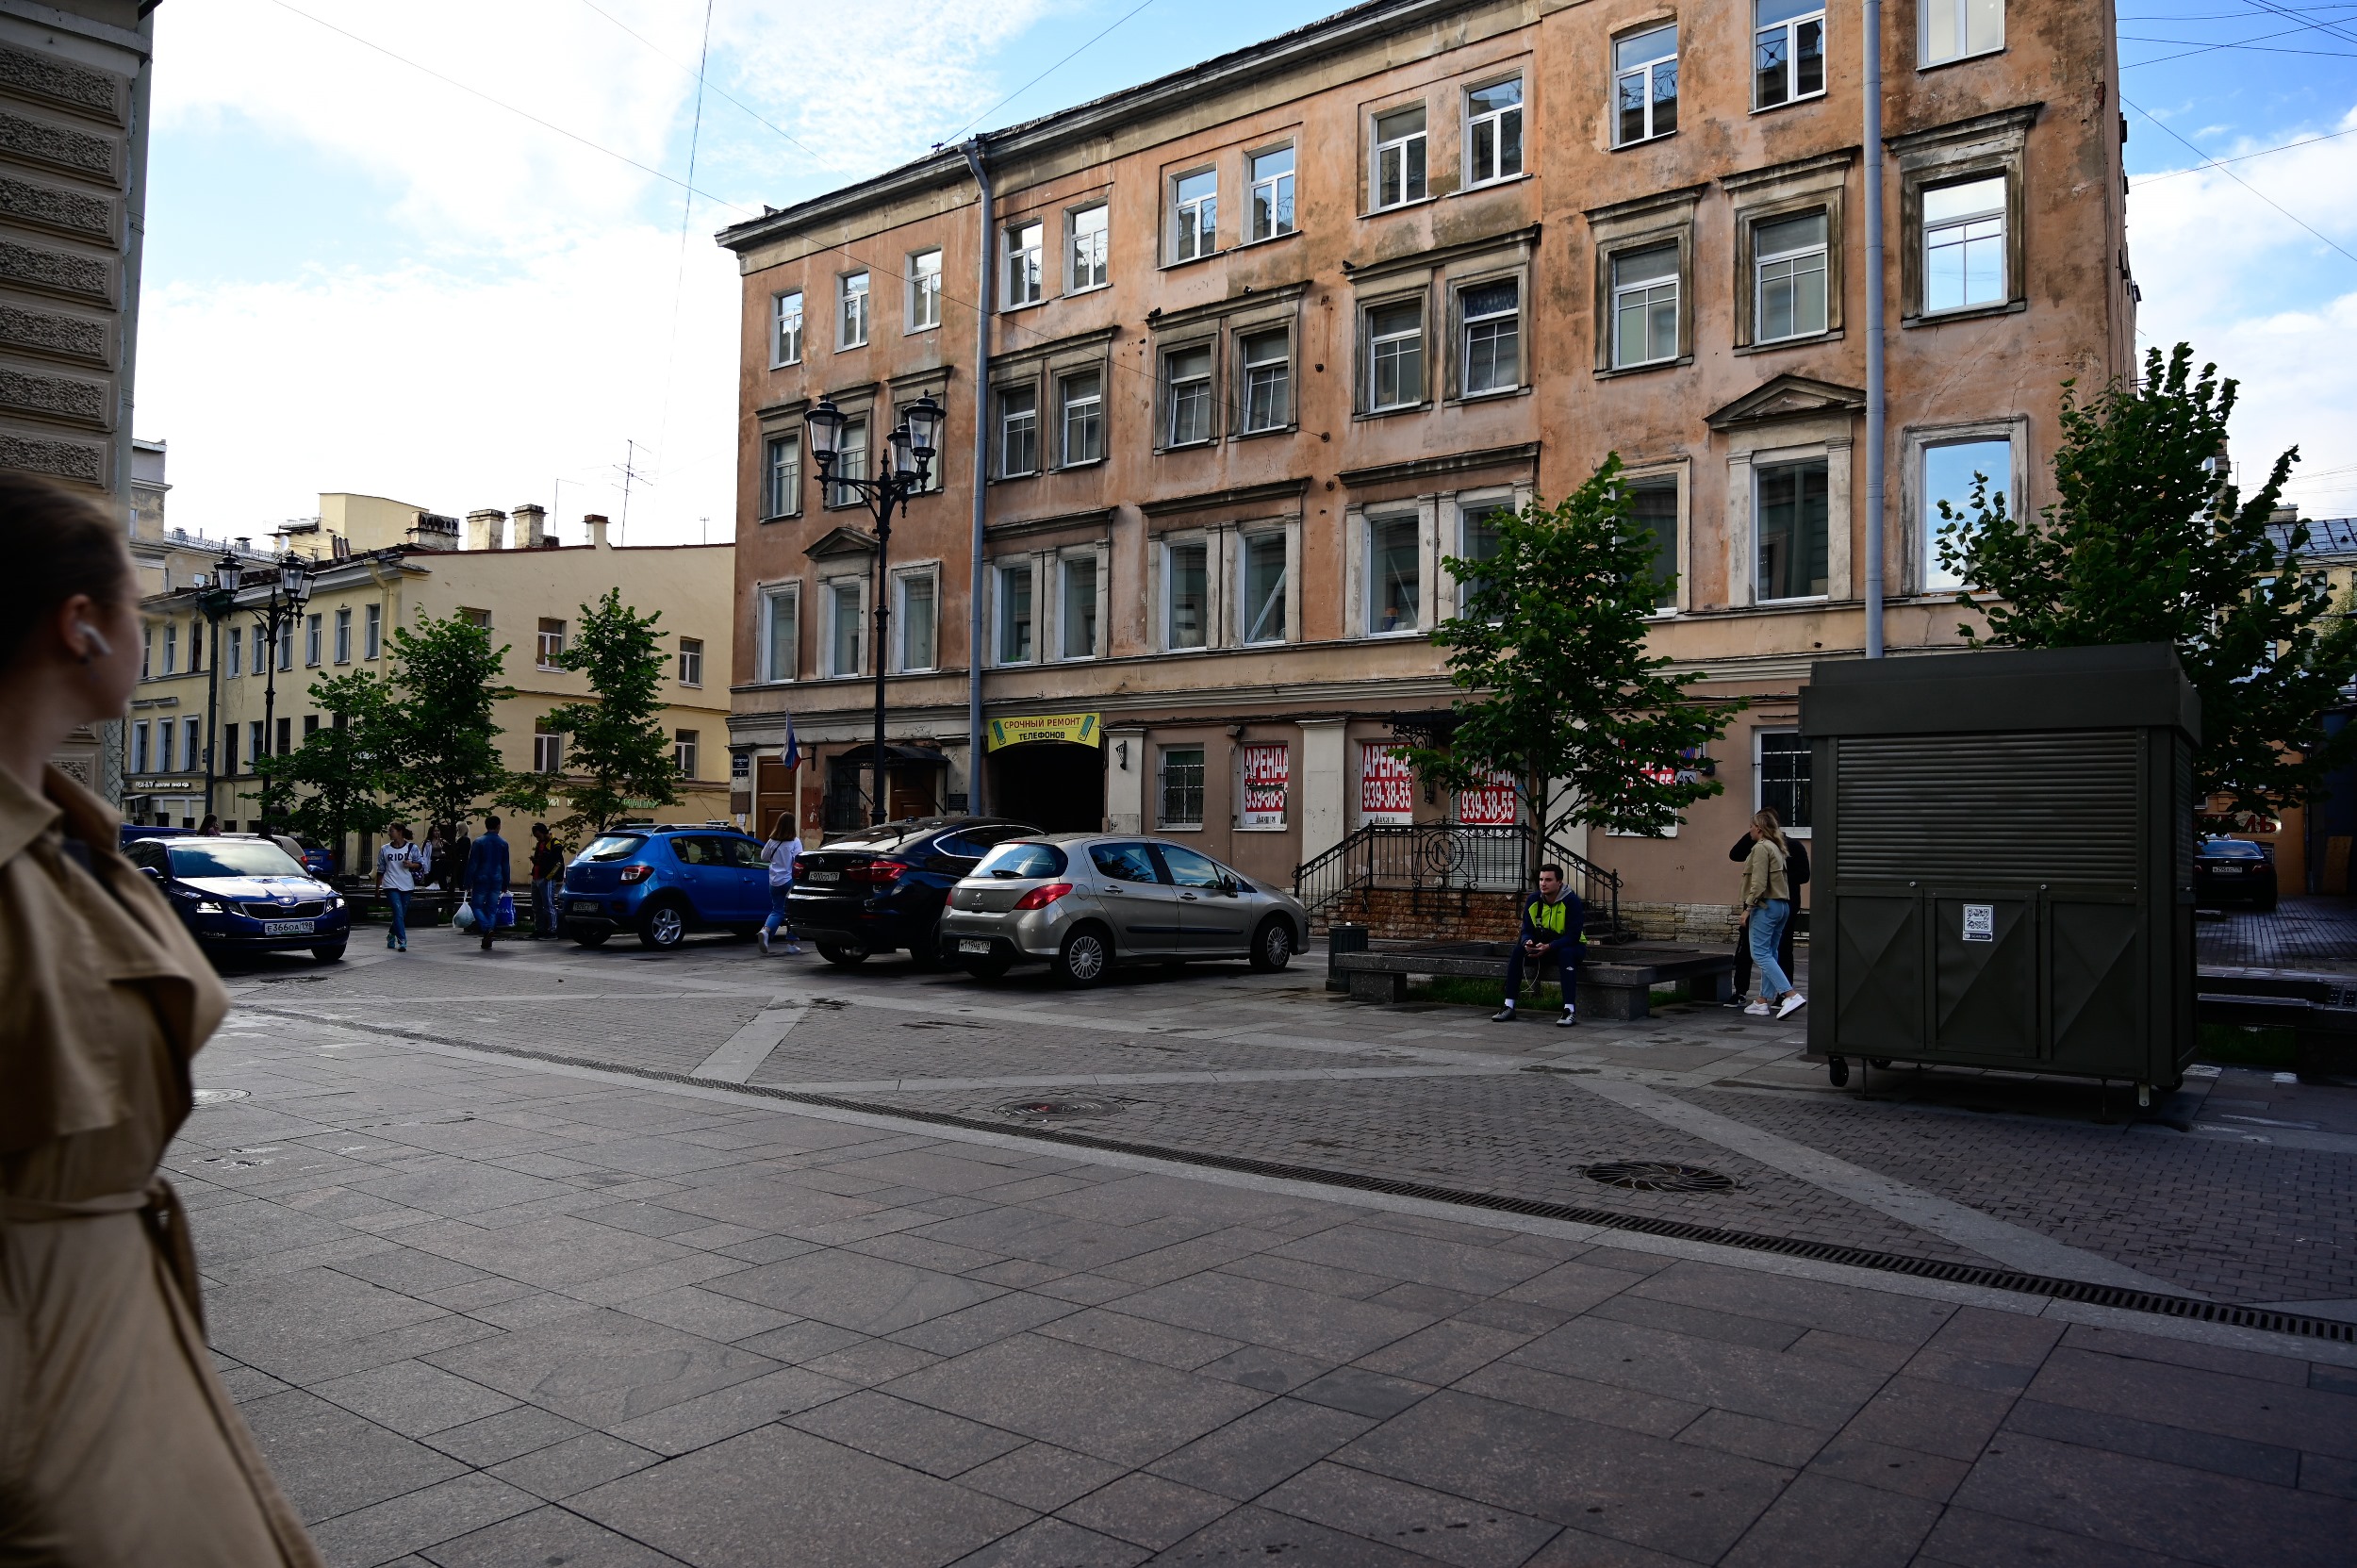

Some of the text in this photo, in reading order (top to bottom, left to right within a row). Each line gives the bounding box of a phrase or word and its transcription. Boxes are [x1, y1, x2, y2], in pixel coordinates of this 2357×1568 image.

[1004, 717, 1080, 729] СРОЧНЫЙ РЕМОНТ
[1018, 731, 1065, 741] ТЕЛЕФОНОВ
[1363, 781, 1411, 808] 939-38-55
[1461, 790, 1514, 820] 939-38-55
